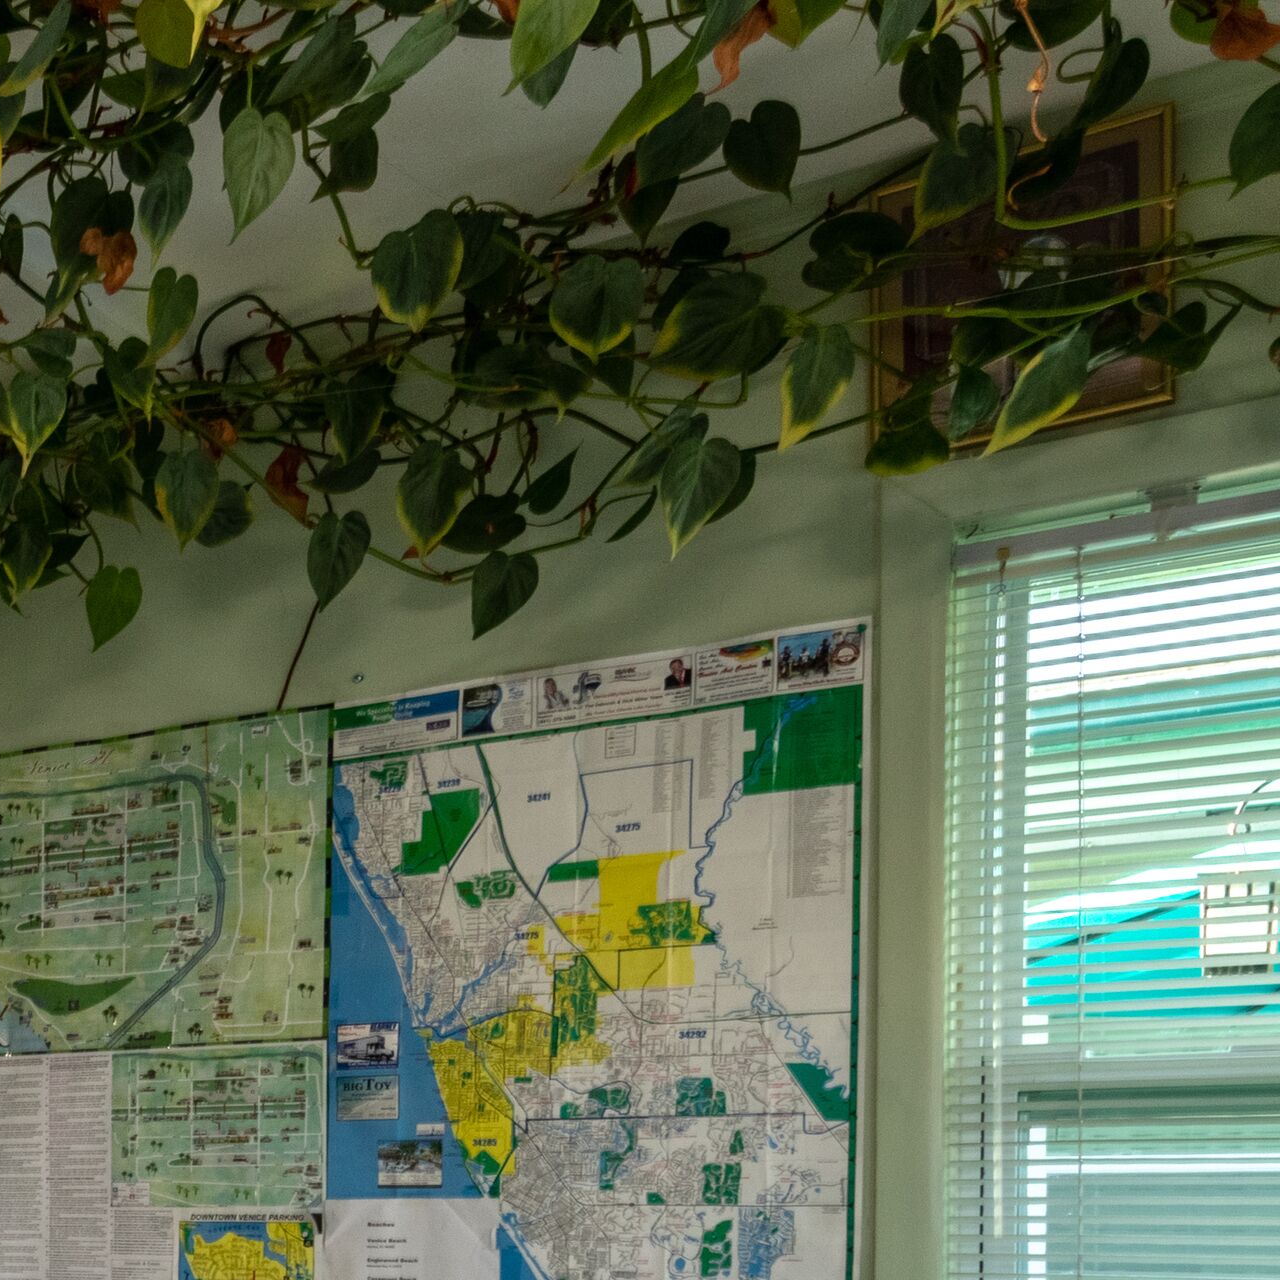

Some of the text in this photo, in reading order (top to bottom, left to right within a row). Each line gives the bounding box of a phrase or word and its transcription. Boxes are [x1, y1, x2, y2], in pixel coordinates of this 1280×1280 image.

[615, 822, 641, 833] 34275
[678, 1030, 707, 1040] 34292
[472, 1138, 497, 1147] 34285
